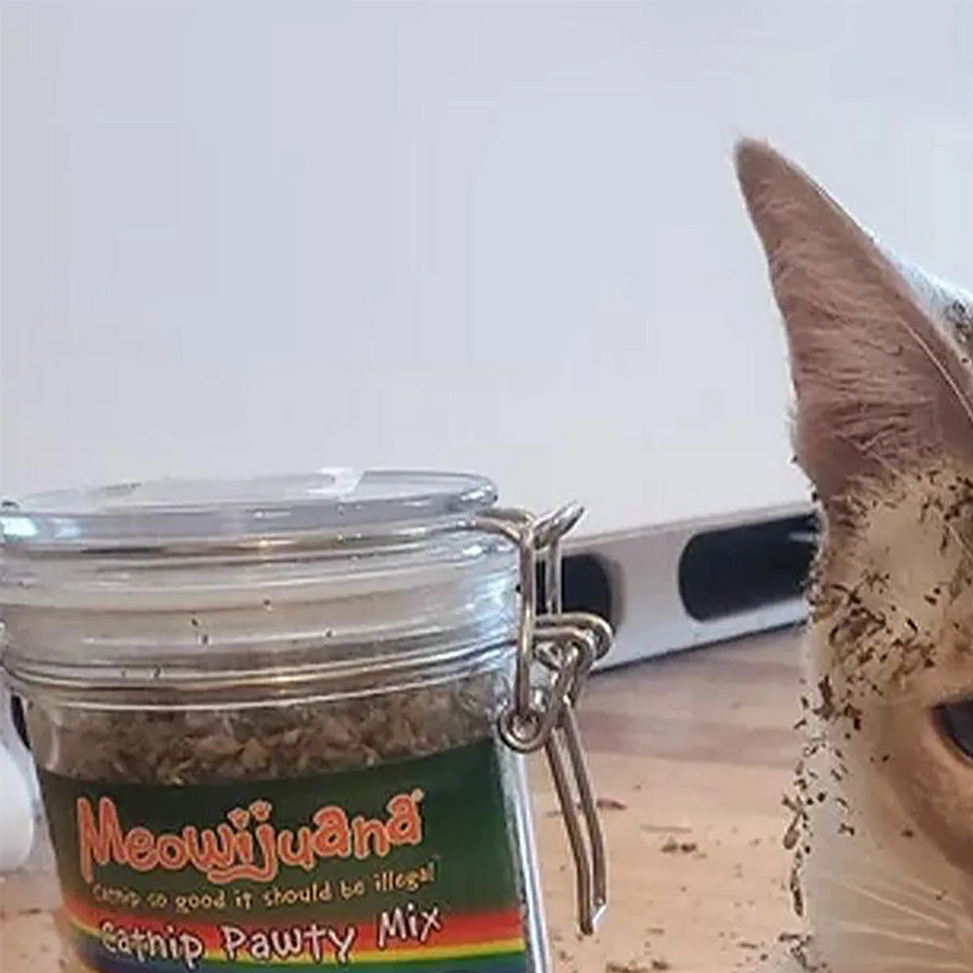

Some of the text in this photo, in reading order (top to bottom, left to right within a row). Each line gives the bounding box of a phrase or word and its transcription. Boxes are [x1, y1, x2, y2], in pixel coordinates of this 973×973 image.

[76, 788, 424, 885] Meowijuana
[174, 889, 226, 915] good
[235, 889, 253, 911] it
[262, 880, 333, 907] should
[340, 879, 365, 899] be
[101, 919, 204, 971] Catnip
[377, 901, 442, 949] Mix
